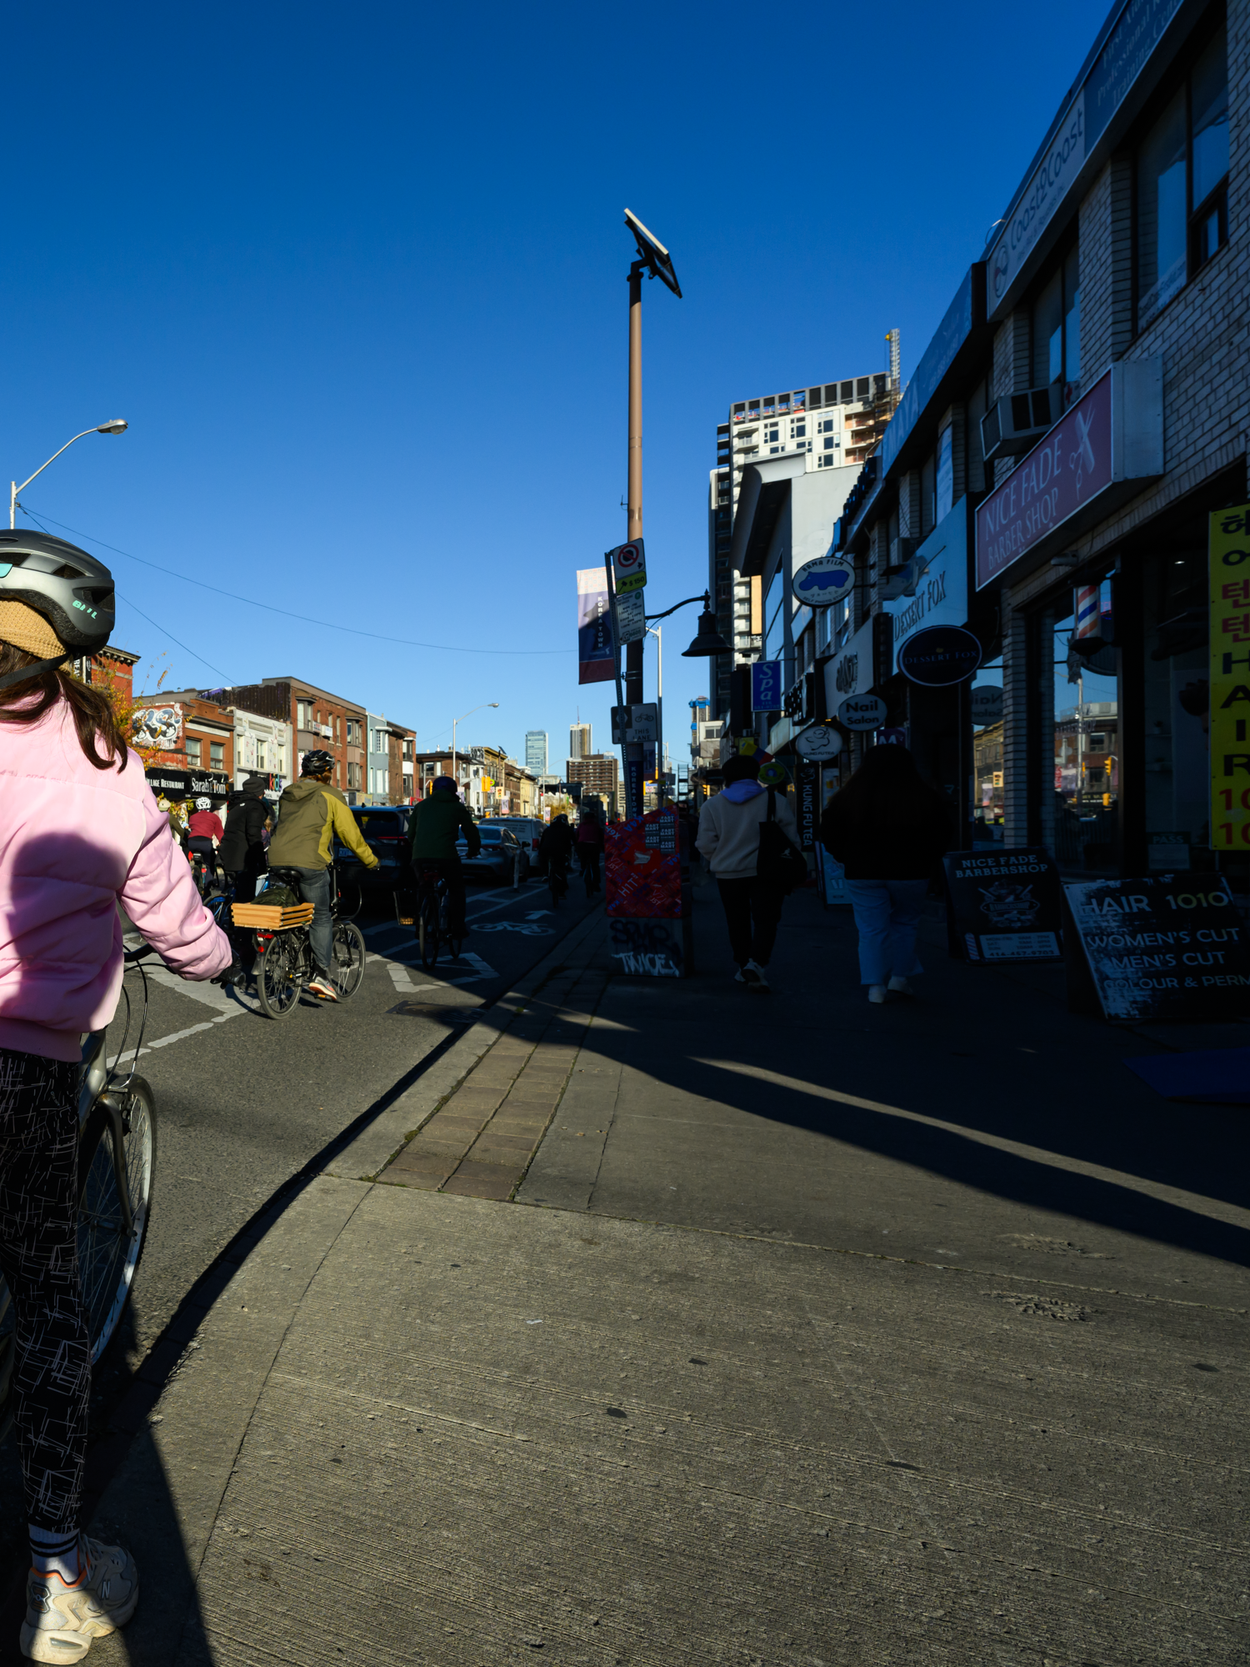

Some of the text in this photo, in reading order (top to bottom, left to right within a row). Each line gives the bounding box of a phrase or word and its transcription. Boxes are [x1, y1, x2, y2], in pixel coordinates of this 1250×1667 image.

[986, 434, 1062, 540] NICE FADE
[988, 487, 1059, 570] BARBER SHOP
[827, 559, 844, 567] FILM
[635, 576, 645, 585] 150
[895, 571, 946, 642] DESSERT FOX
[905, 650, 978, 665] DESSERT FOX
[759, 663, 773, 700] Spa
[846, 700, 878, 712] Nail
[192, 777, 209, 792] Sarah
[803, 785, 812, 846] KUNG FU TEA
[1153, 835, 1183, 844] PASS
[961, 854, 1038, 868] NICE FADE
[955, 863, 1048, 878] BARBERSHOP
[1081, 891, 1230, 914] HAIR 1010
[1087, 928, 1239, 948] WOMEN'S CUT
[1110, 951, 1225, 968] MEN'S CUT
[1103, 977, 1179, 989] COLOUR
[1184, 976, 1198, 988] &
